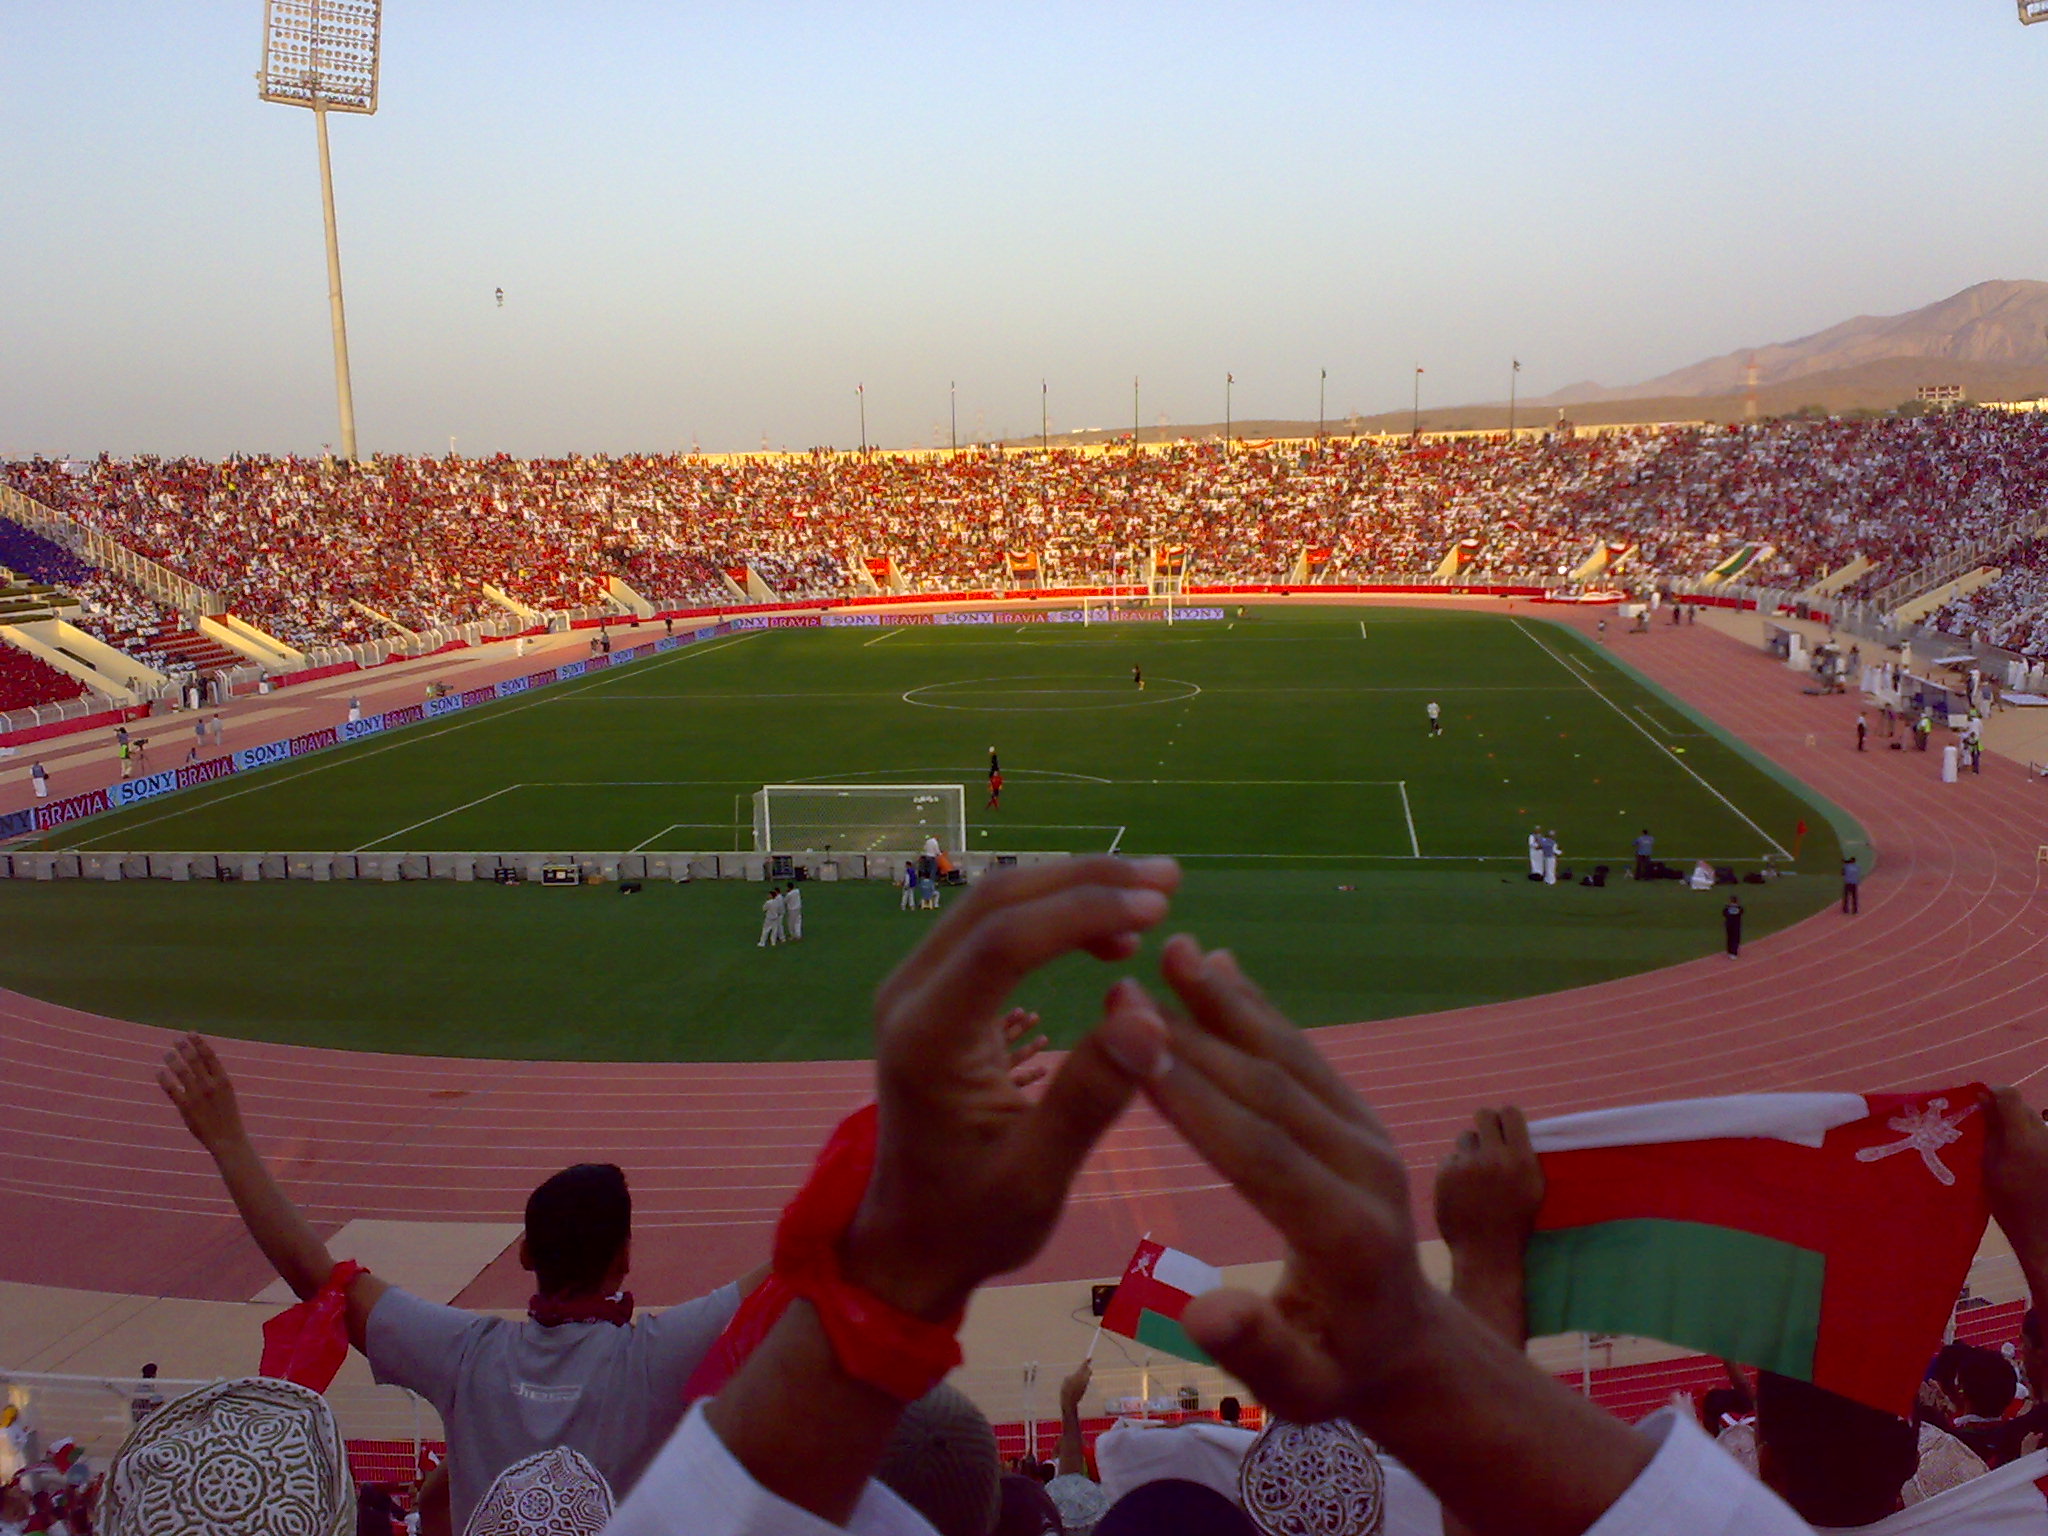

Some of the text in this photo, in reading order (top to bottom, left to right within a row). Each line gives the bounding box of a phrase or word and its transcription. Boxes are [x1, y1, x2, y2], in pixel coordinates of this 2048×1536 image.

[996, 614, 1045, 624] BRAVIA
[346, 714, 381, 737] SONY
[244, 730, 335, 764] SONY BRAVIA
[121, 758, 233, 800] SONY BRAVIA
[37, 794, 106, 831] BRAVIA
